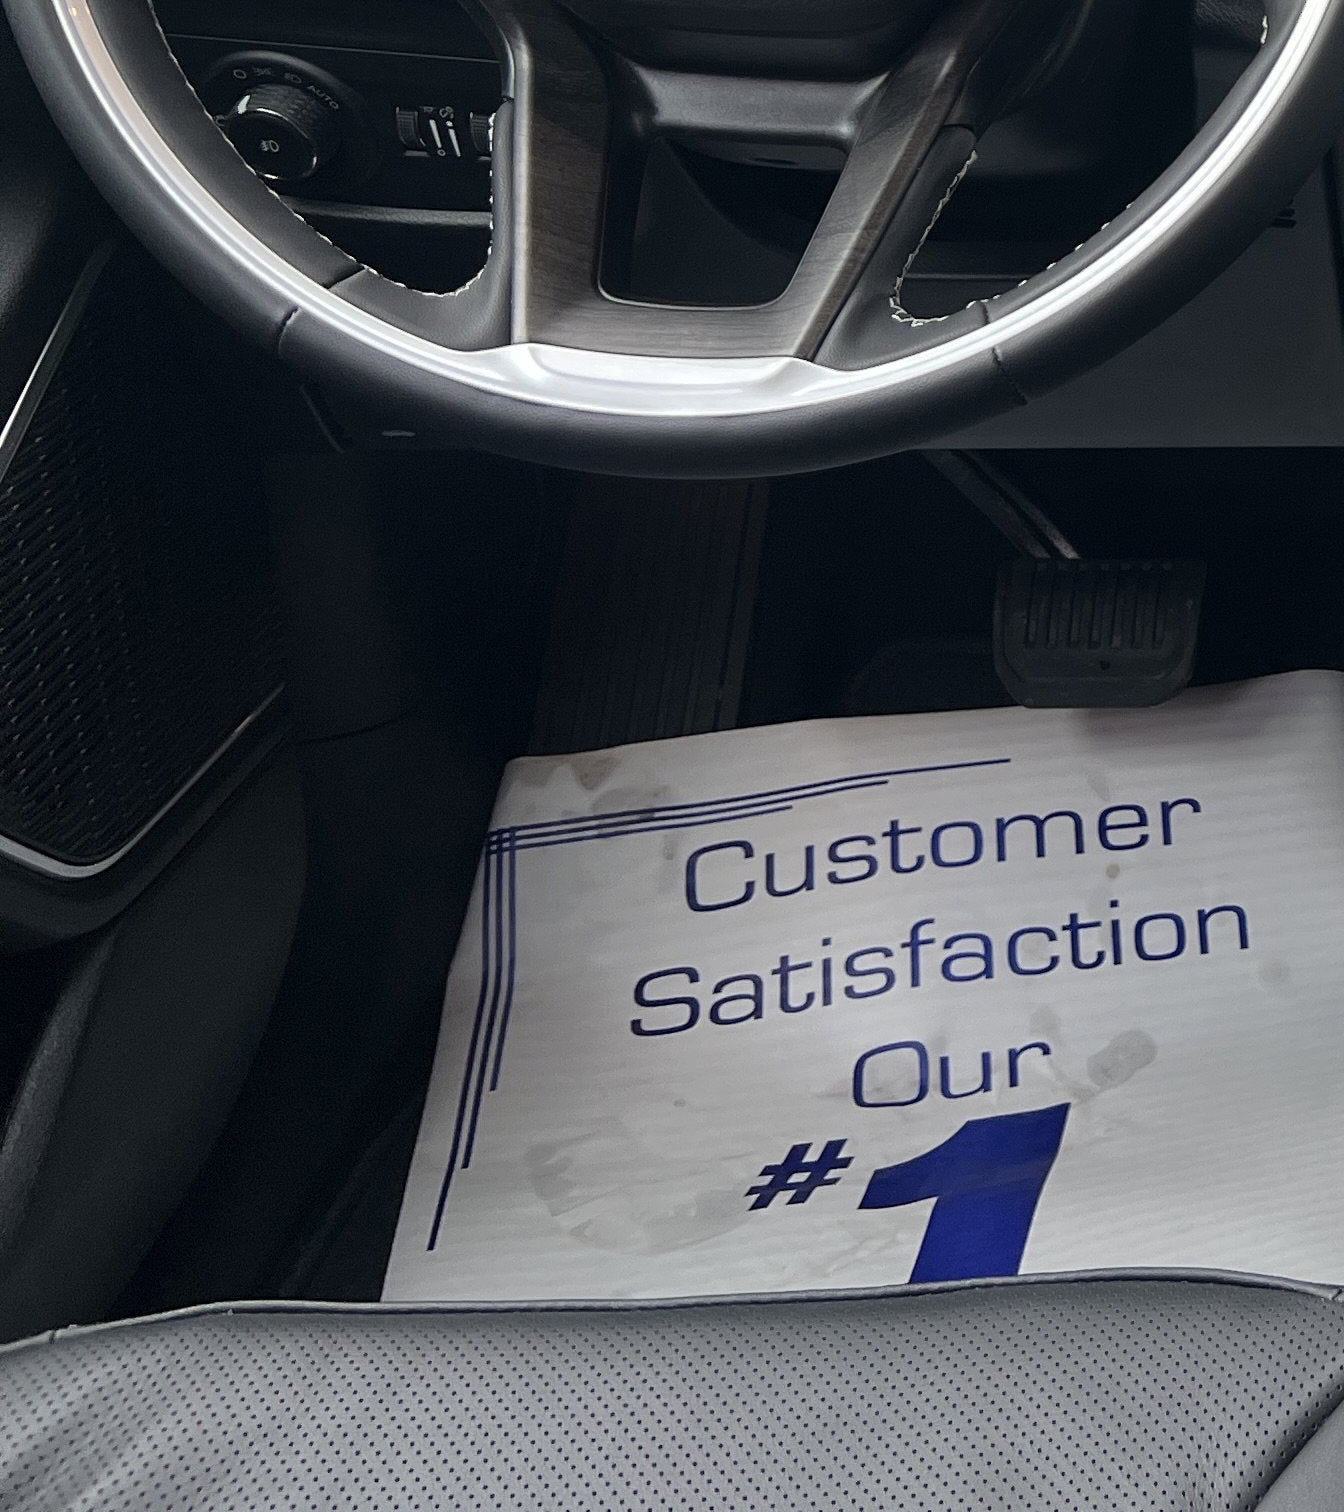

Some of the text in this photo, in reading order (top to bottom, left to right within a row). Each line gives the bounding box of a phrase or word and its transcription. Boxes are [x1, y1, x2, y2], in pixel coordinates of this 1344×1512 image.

[307, 85, 340, 111] AUTO
[683, 793, 1203, 914] Customer
[628, 898, 1252, 1038] Satisfaction
[851, 1037, 1053, 1110] Our
